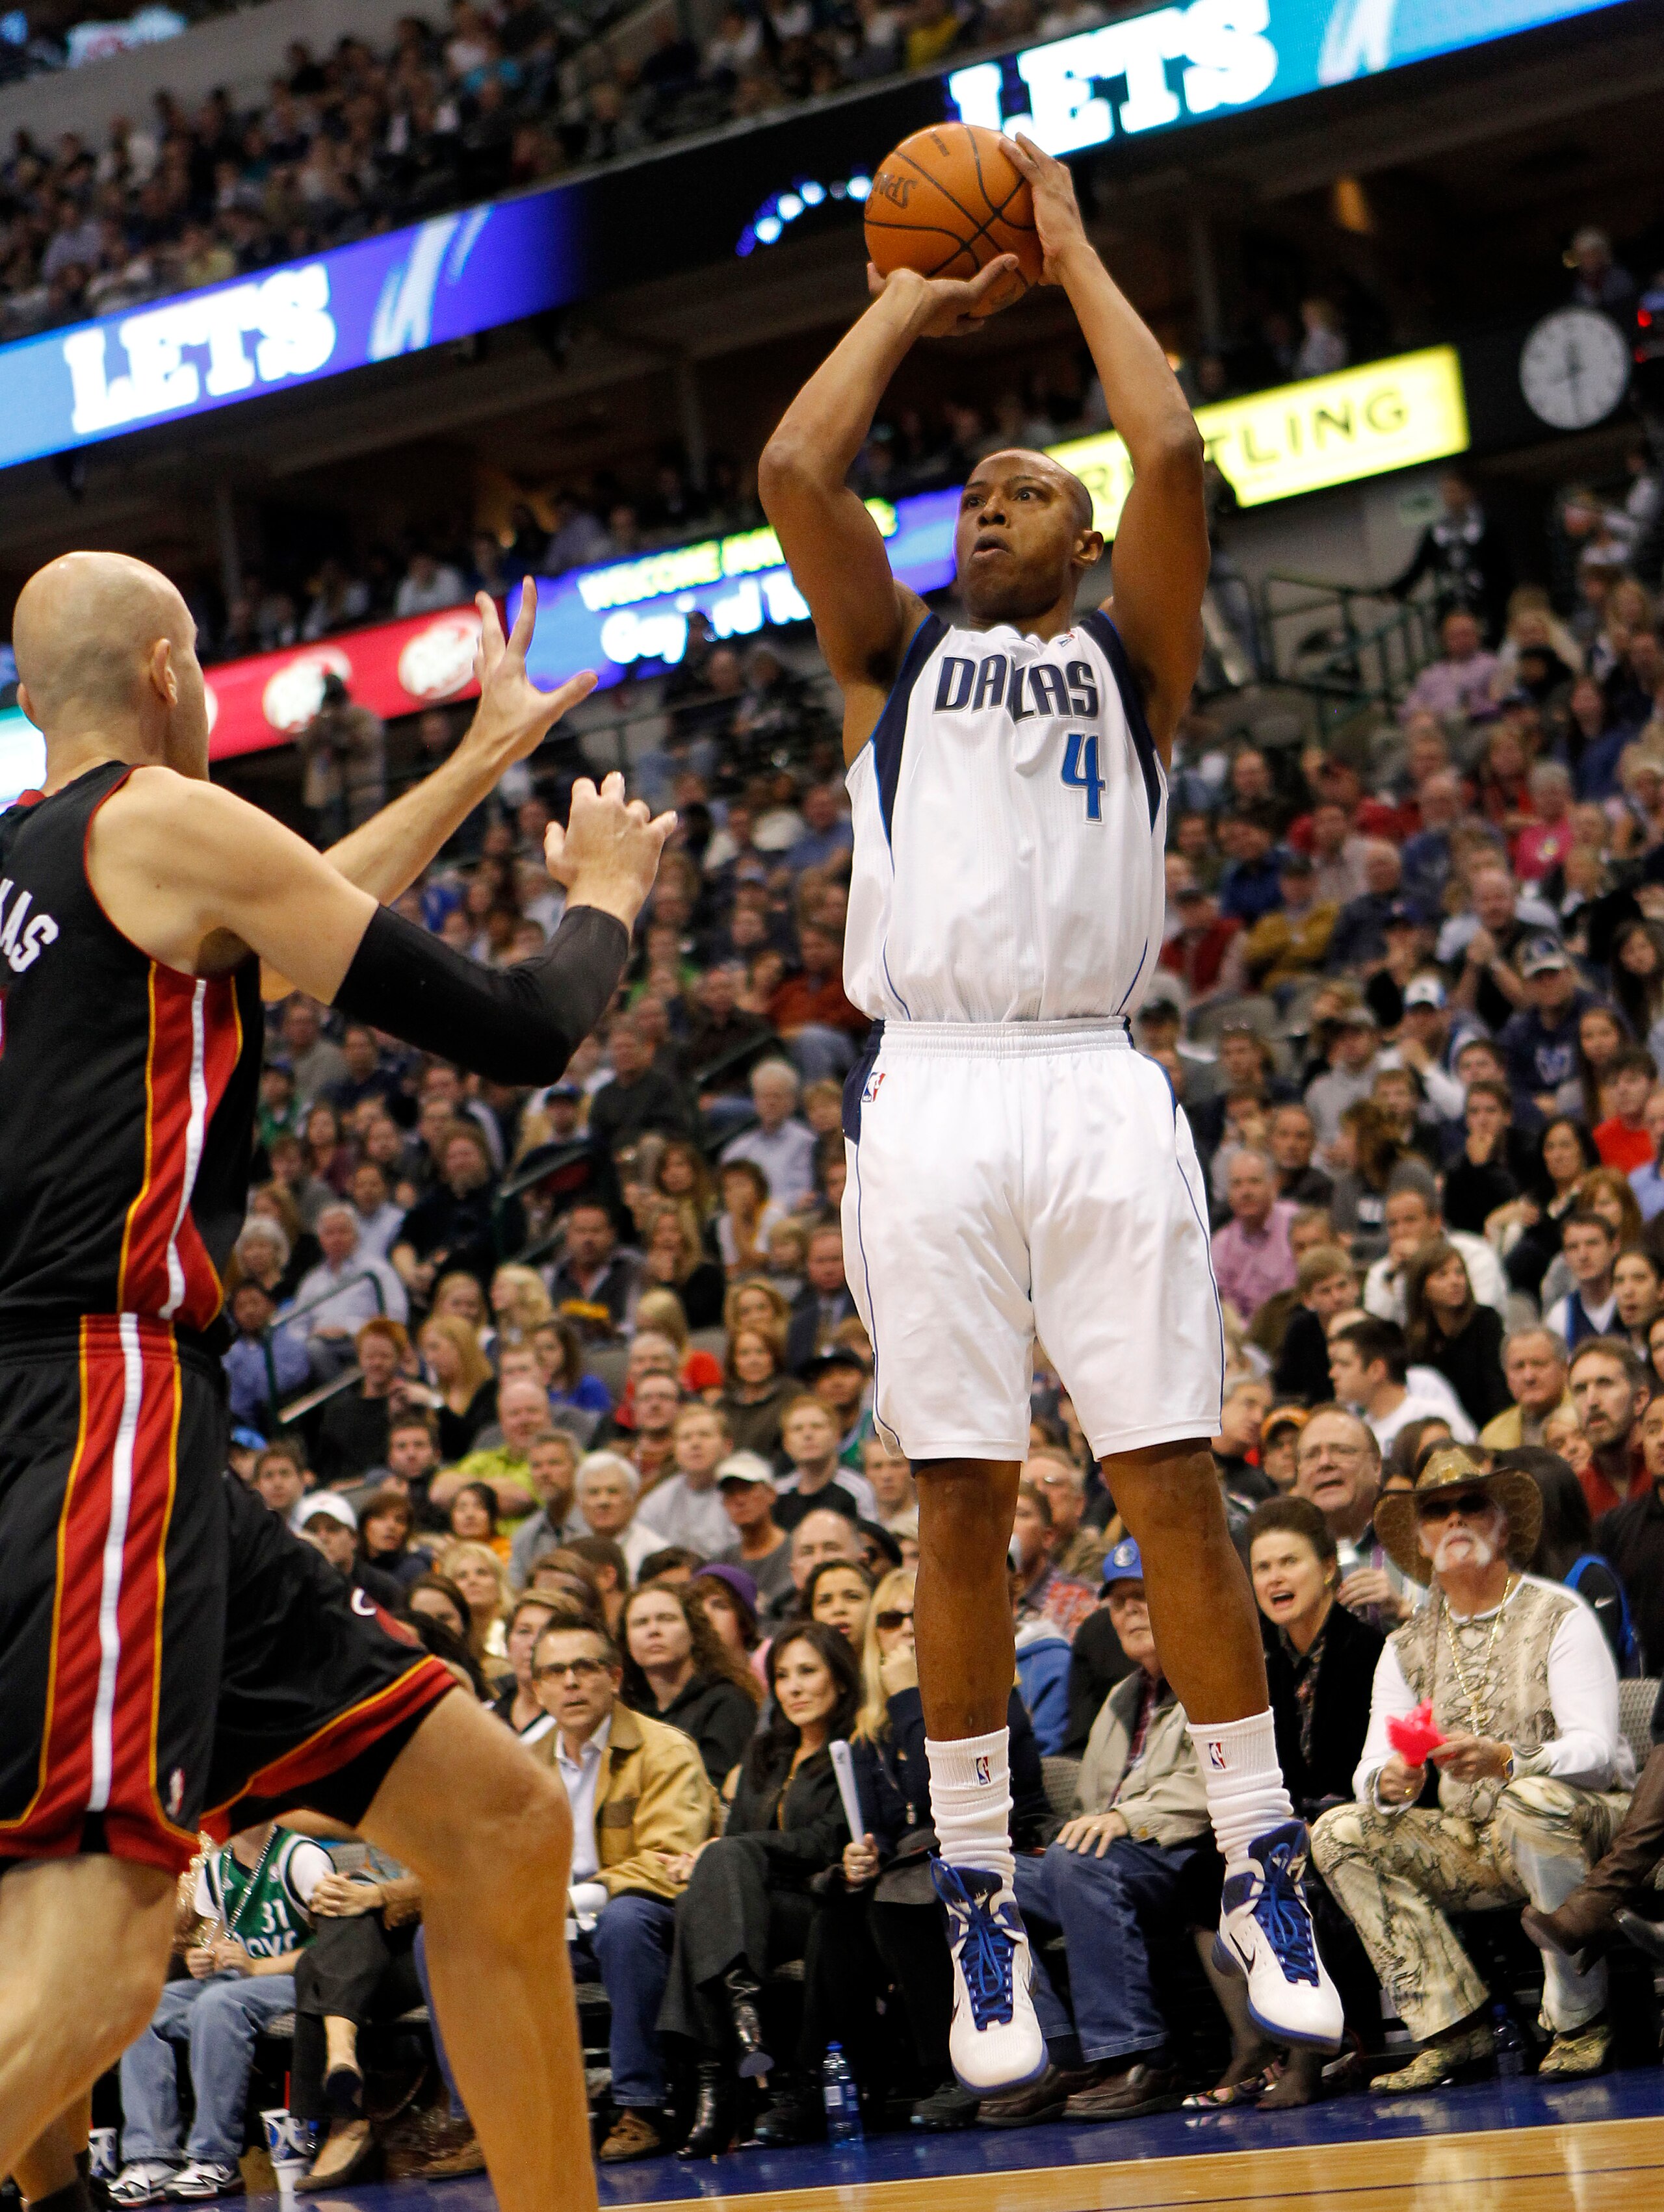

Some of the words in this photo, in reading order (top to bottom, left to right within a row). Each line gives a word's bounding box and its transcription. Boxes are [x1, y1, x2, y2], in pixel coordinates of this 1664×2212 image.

[948, 0, 1277, 157] LETS
[62, 261, 337, 435] LETS
[933, 654, 1100, 725] DALAS
[1060, 732, 1108, 823] 4
[261, 1898, 291, 1933] 31
